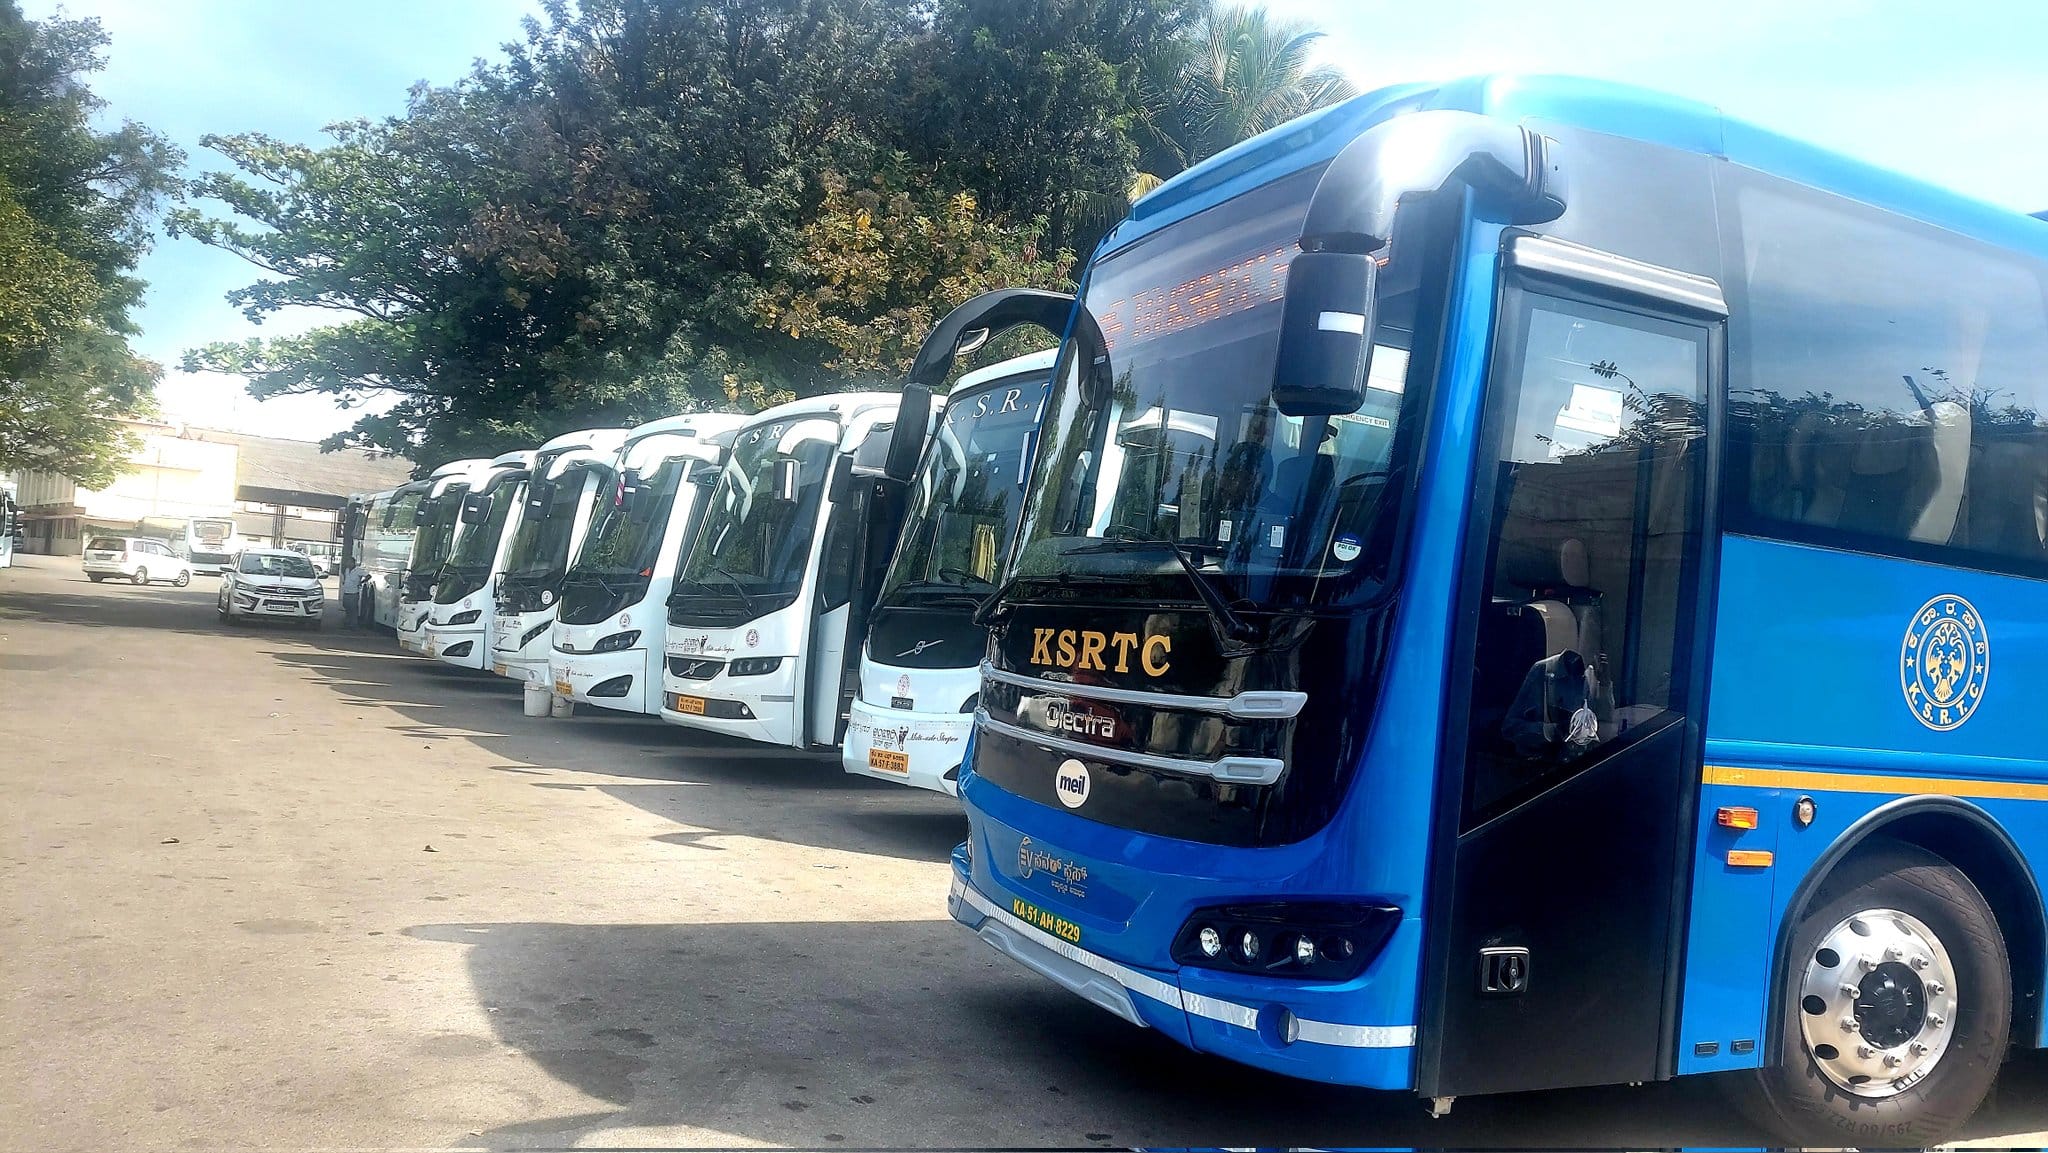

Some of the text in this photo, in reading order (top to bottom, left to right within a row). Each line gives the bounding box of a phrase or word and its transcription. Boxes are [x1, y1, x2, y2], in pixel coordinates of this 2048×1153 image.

[1030, 627, 1172, 678] KSRTC
[1046, 701, 1116, 739] Olectra
[1060, 774, 1086, 796] meil
